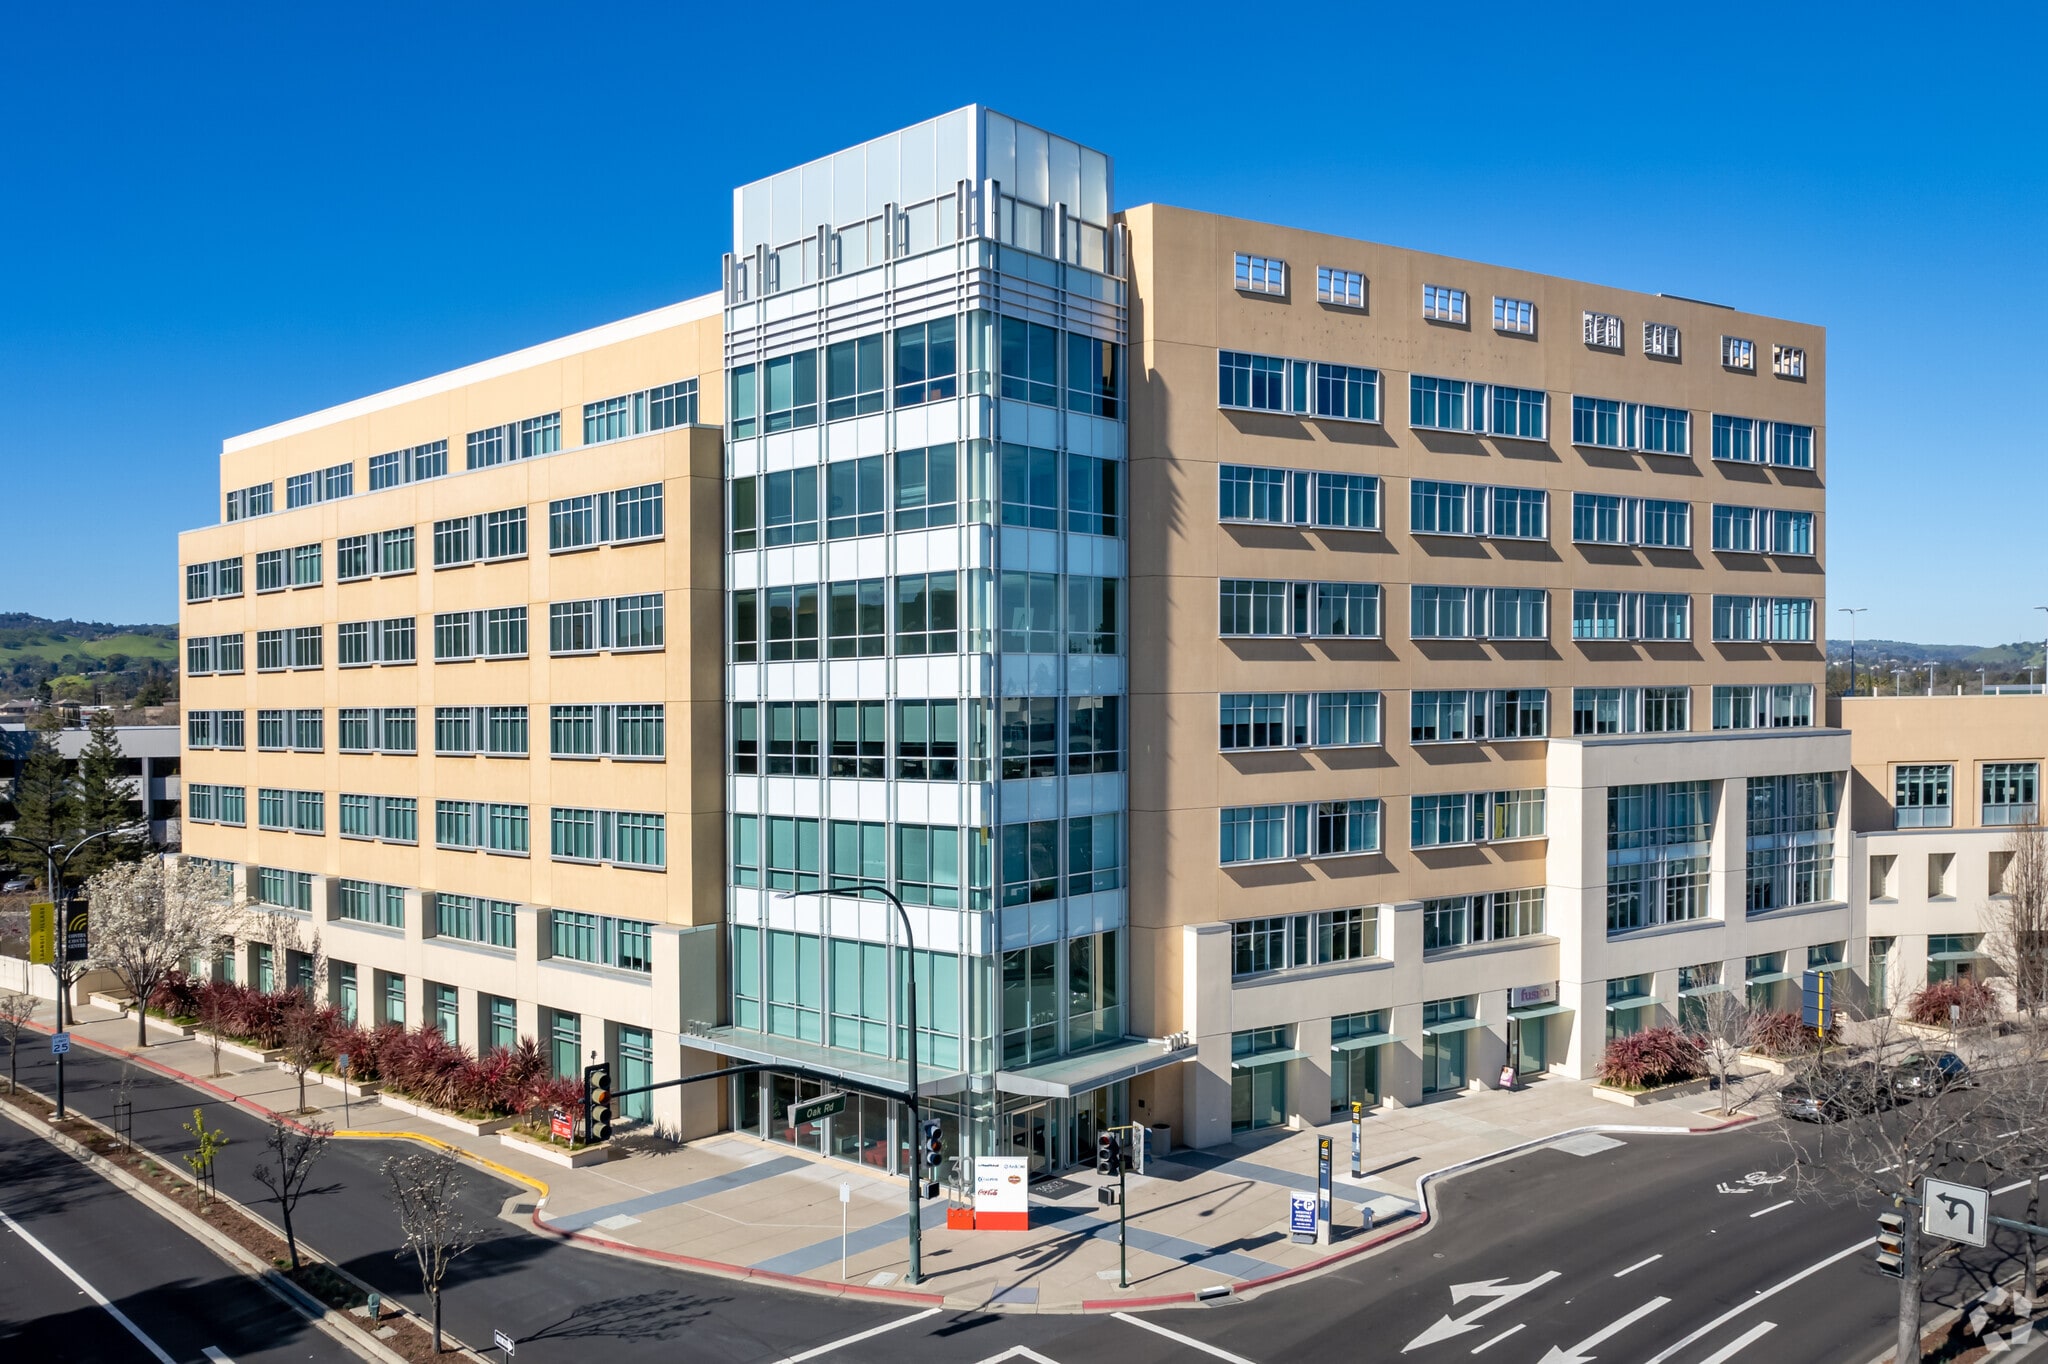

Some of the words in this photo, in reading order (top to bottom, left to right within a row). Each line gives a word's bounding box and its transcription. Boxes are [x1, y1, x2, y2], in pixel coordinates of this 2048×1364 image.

[1521, 987, 1550, 1001] fusion
[53, 1043, 68, 1053] 25
[806, 1106, 821, 1118] Oak
[824, 1102, 834, 1113] Rd
[1306, 1201, 1312, 1209] P
